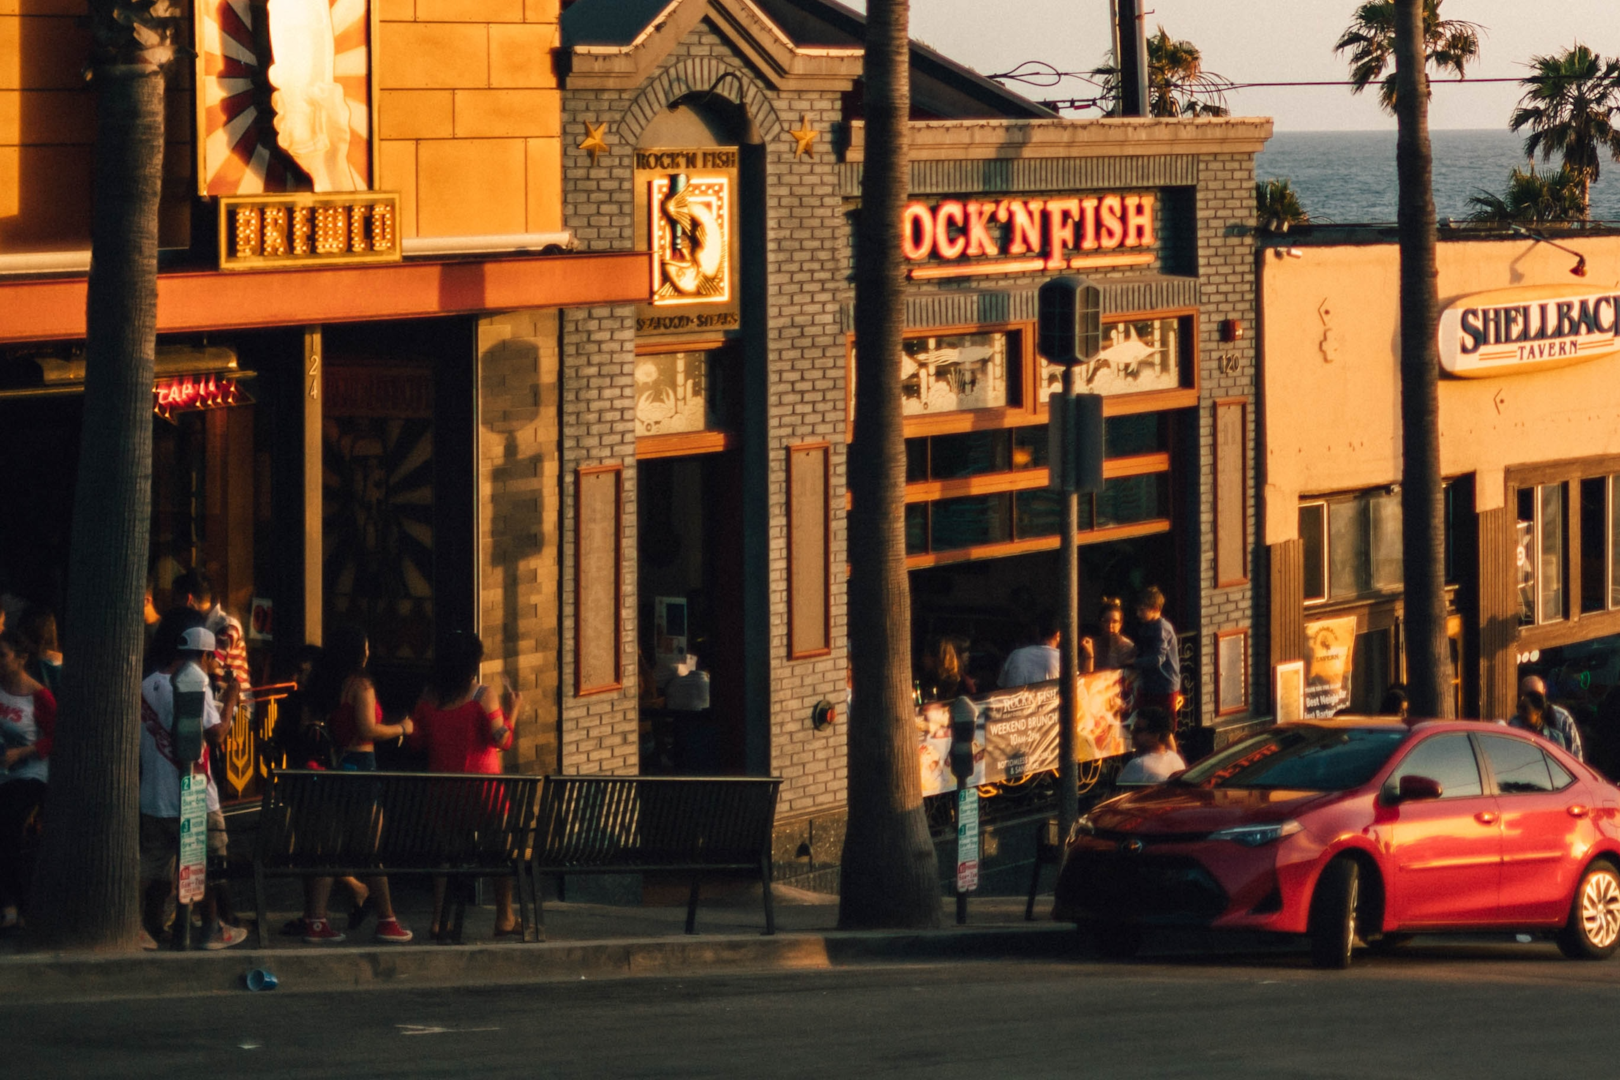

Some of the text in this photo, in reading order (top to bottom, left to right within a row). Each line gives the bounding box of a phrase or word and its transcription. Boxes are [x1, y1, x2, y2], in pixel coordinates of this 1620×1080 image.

[636, 151, 737, 170] ROCK'N FISH
[235, 203, 394, 258] BREWCO
[902, 194, 1156, 270] OCK'N FISH
[1517, 339, 1579, 361] TAVERN
[1221, 354, 1241, 373] 120
[990, 718, 1027, 736] WEEKEND
[1028, 712, 1058, 729] BRUNCH
